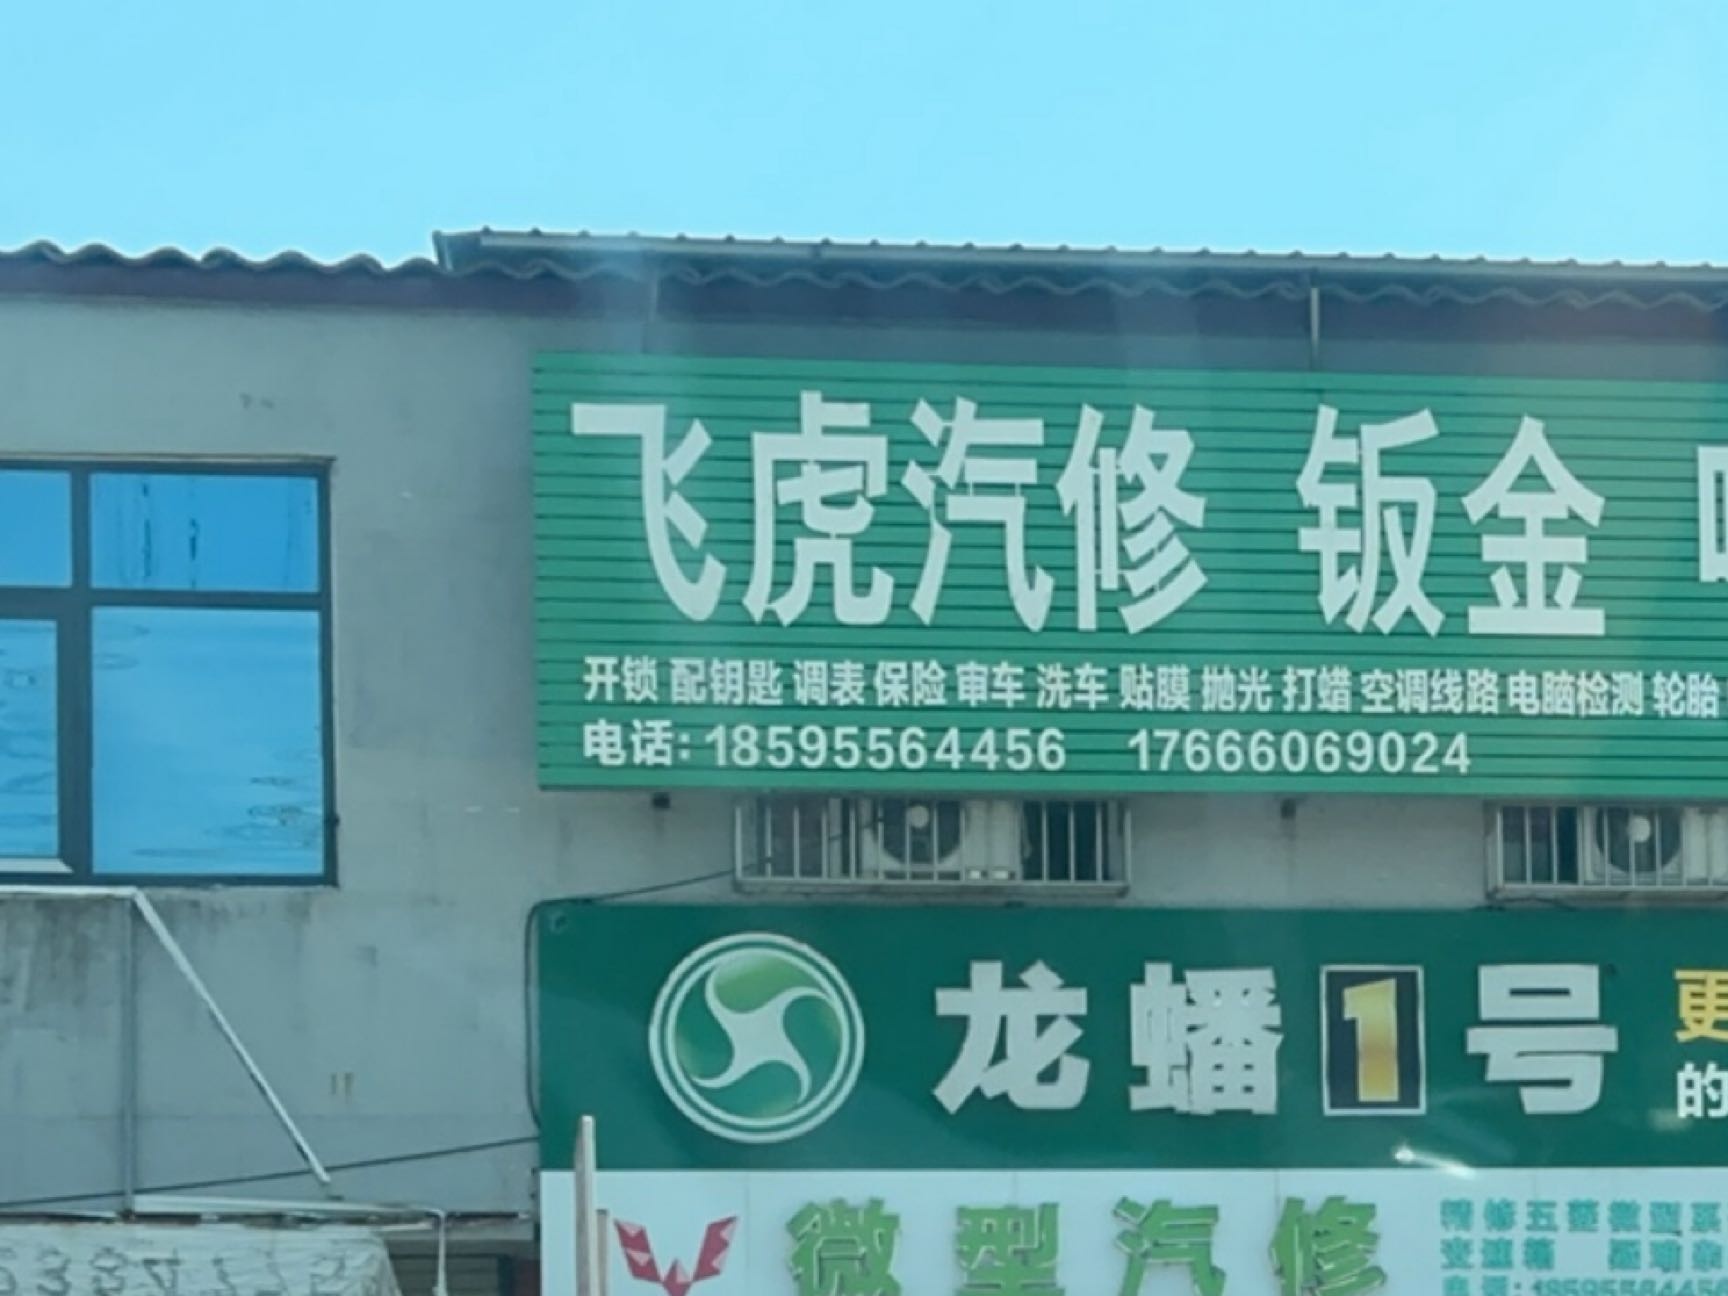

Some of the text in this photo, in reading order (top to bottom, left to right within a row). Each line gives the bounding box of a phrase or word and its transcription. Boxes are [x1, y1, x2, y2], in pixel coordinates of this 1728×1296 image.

[571, 390, 1208, 634] 飞虎汽修
[1296, 405, 1605, 636] 钣金
[583, 656, 658, 702] 开锁
[670, 657, 783, 705] 配钥匙
[792, 660, 866, 705] 调表
[873, 660, 947, 706] 保险
[956, 661, 1026, 707] 审车
[1037, 662, 1109, 709] 洗车
[1120, 663, 1191, 710] 贴膜
[1201, 666, 1272, 711] 抛光
[1282, 666, 1352, 712] 打蜡
[1361, 668, 1500, 713] 空调线路
[1507, 669, 1644, 716] 电脑检测
[1653, 671, 1720, 717] 轮胎
[1129, 729, 1471, 773] 17666069024
[934, 961, 1618, 1116] 龙蟠1号
